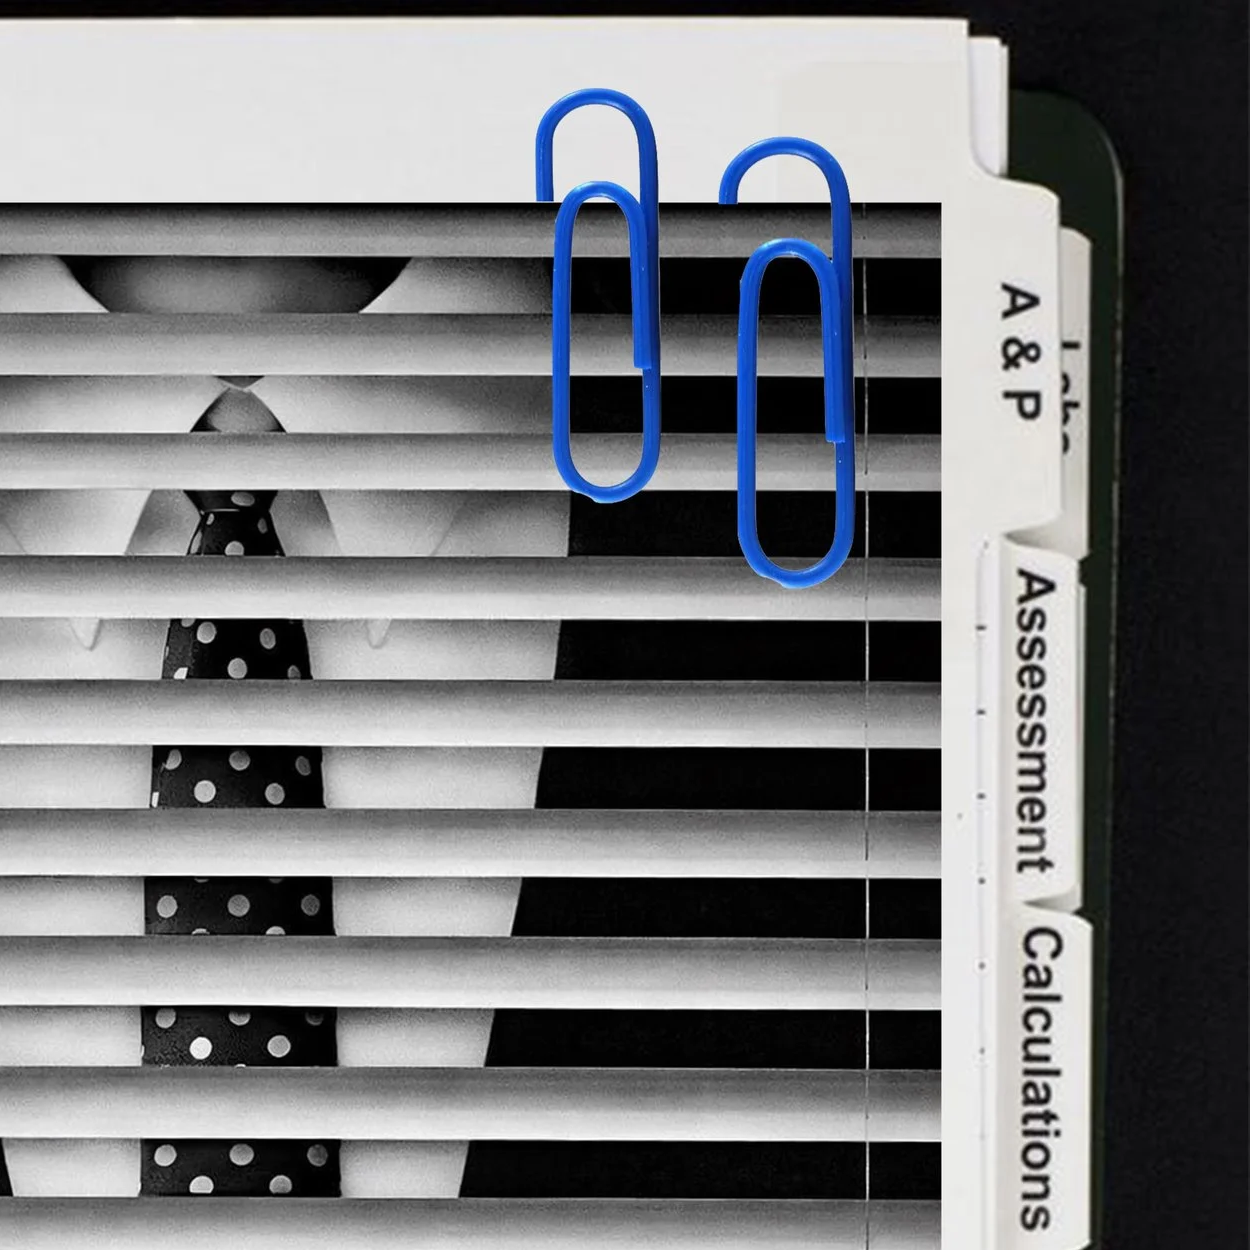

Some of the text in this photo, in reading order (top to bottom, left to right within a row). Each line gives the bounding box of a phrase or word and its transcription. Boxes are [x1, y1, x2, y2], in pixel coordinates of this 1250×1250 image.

[1001, 282, 1042, 421] A & P
[1016, 568, 1057, 873] Assessment
[1020, 926, 1064, 1231] Calculations
